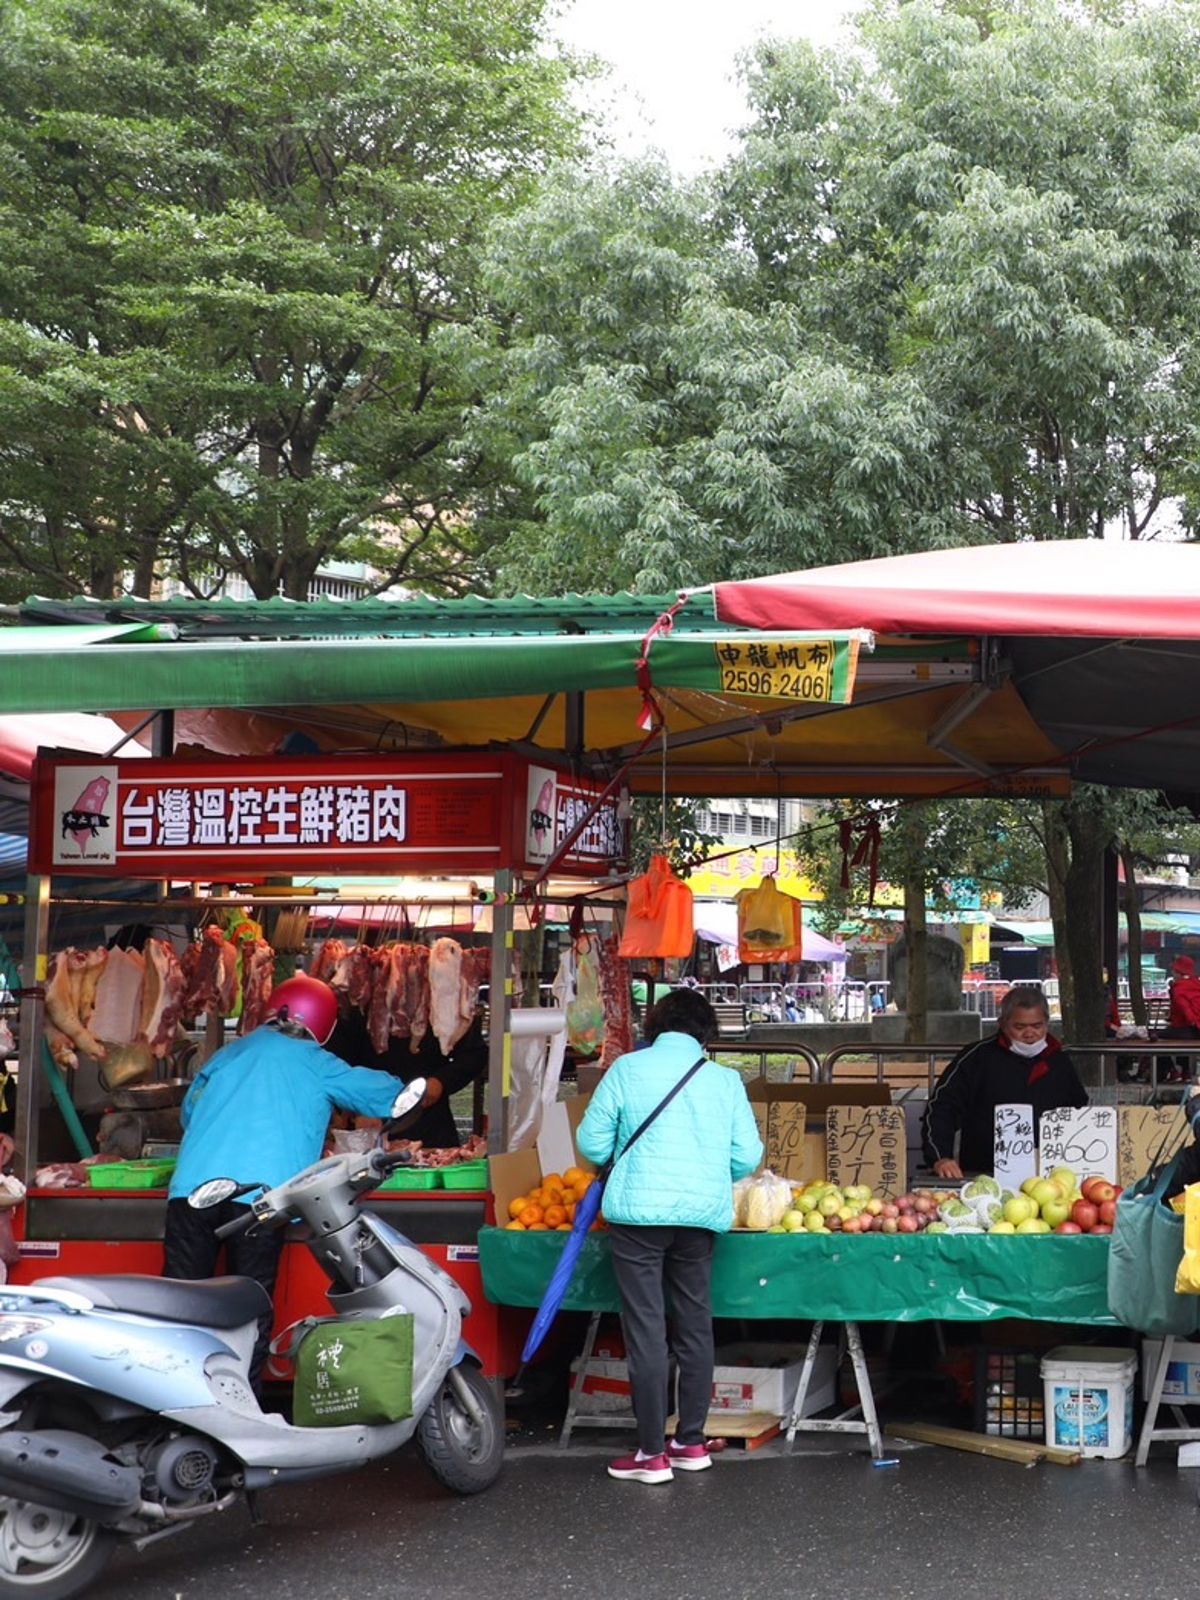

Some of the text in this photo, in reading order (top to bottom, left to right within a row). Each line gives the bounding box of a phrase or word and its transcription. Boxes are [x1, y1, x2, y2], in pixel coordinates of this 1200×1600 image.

[121, 785, 407, 846] 台灣溫控生鮮豬肉
[840, 1121, 876, 1156] 59
[1042, 1124, 1064, 1140] 日本
[1063, 1124, 1109, 1163] 60
